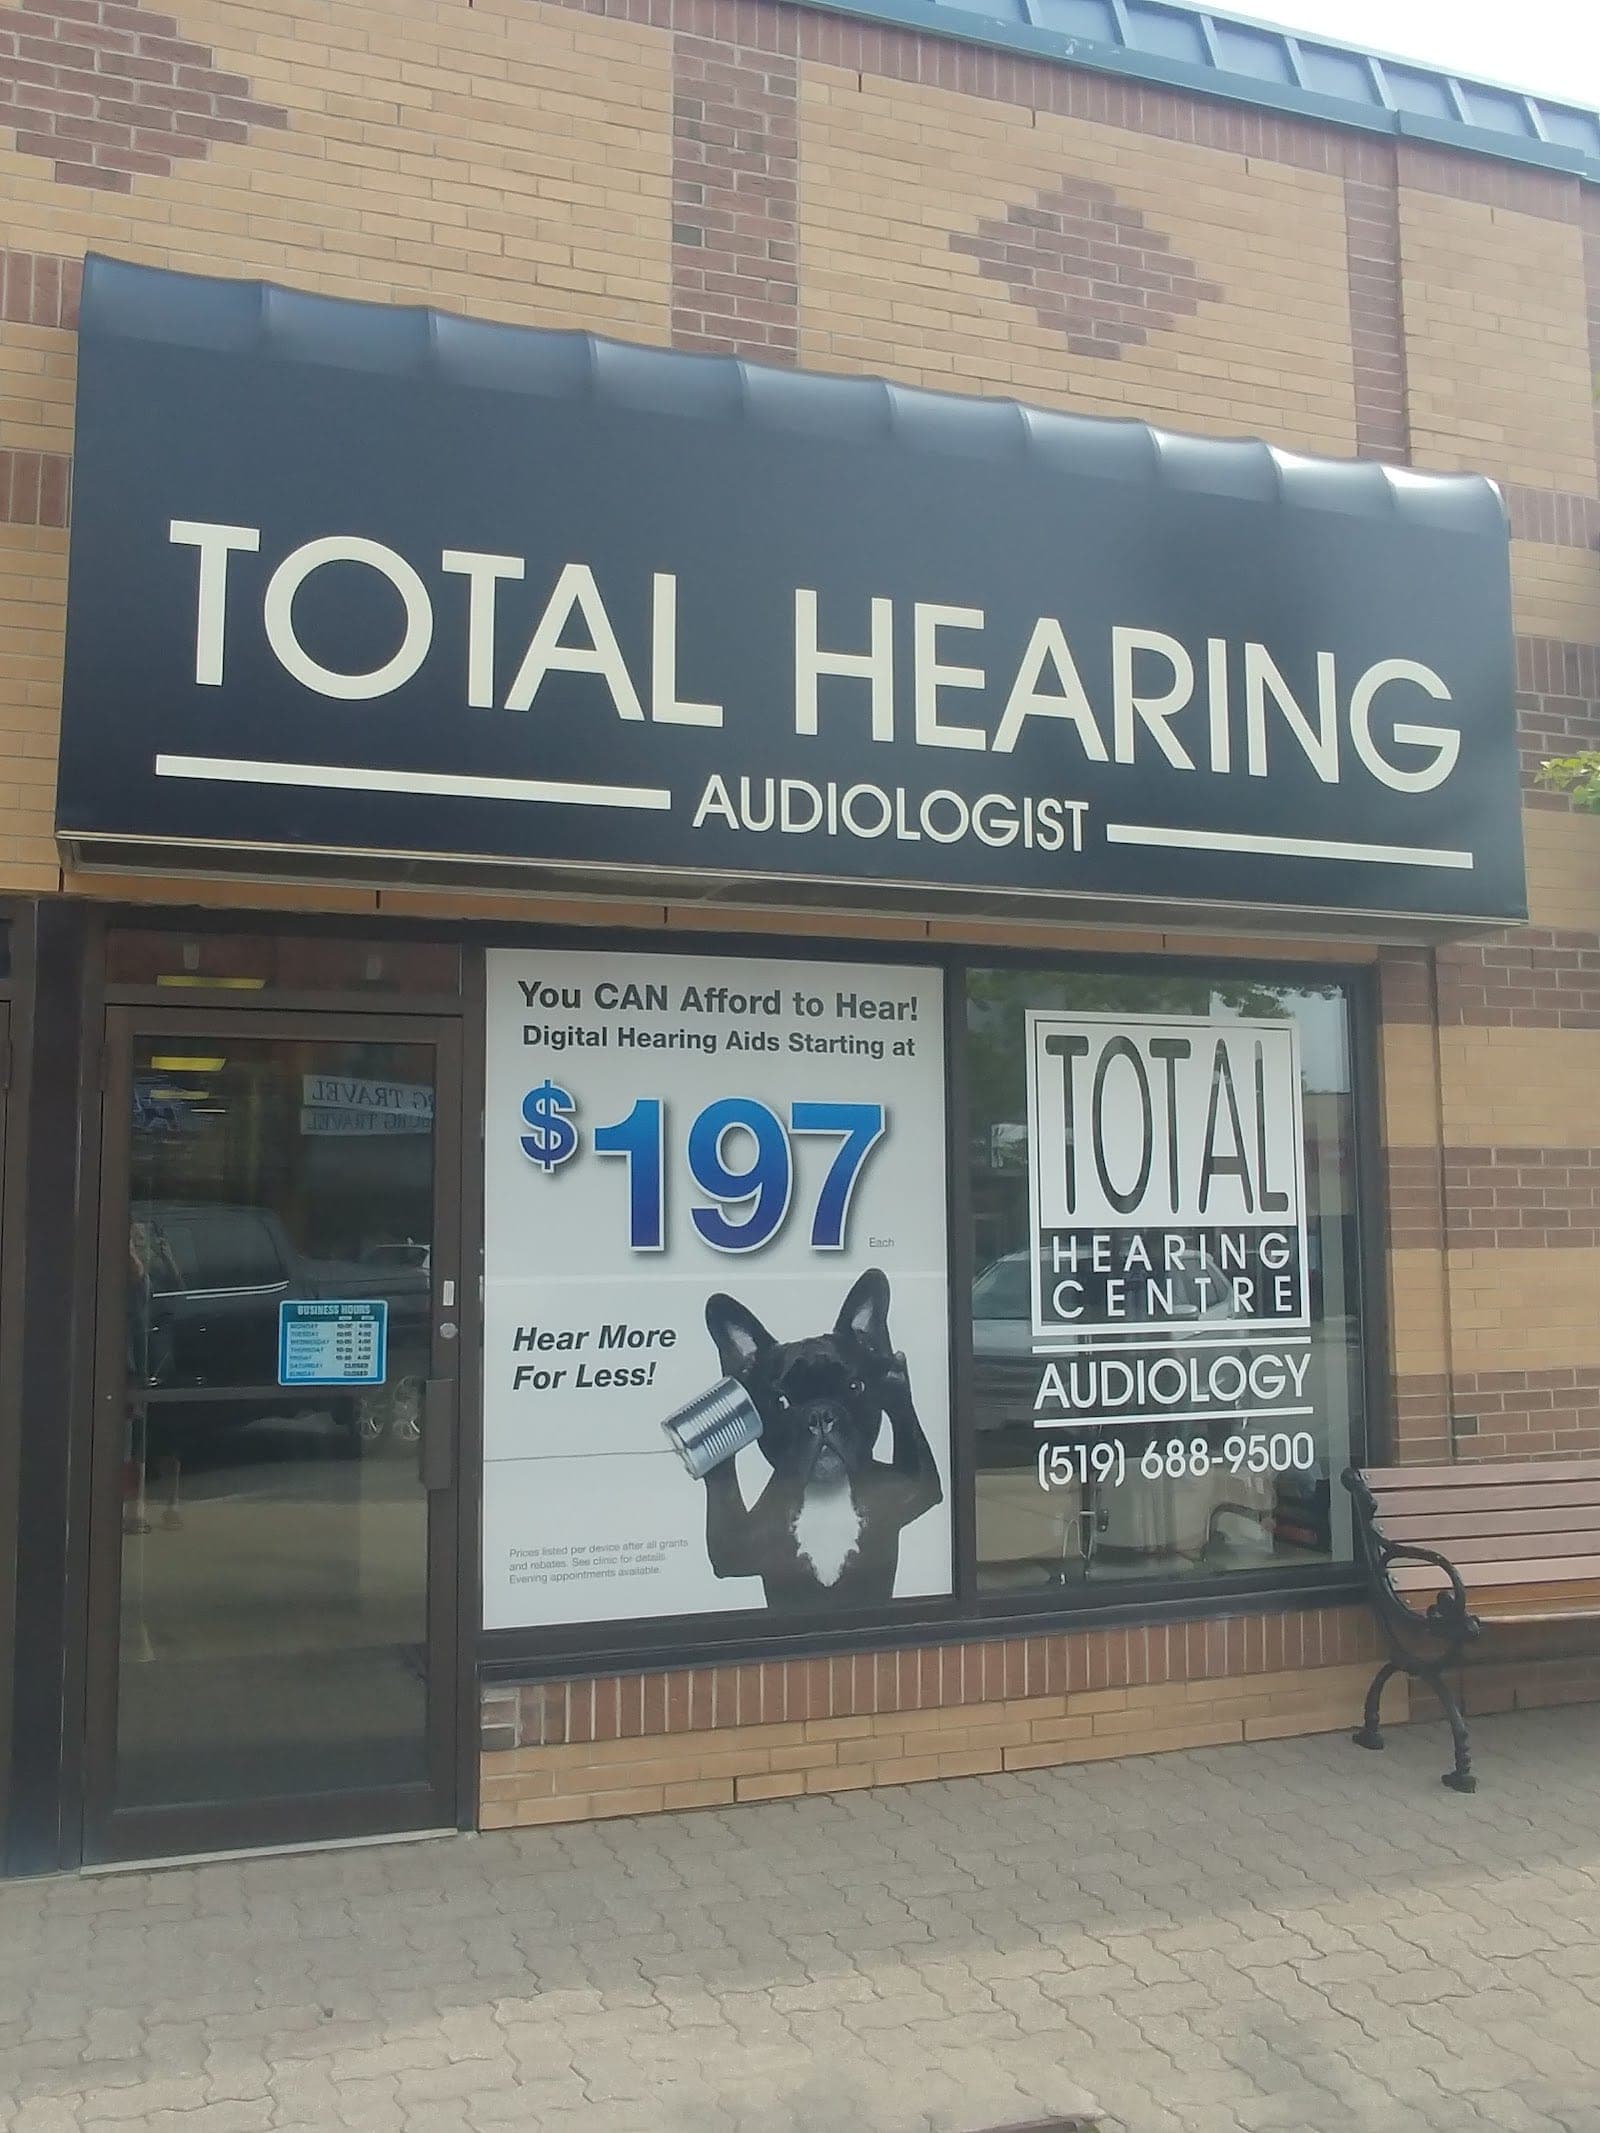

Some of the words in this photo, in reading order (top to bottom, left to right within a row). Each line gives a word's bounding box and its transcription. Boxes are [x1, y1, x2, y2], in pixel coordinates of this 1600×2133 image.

[169, 519, 723, 728] TOTAL
[795, 588, 1461, 793] HEARING
[692, 773, 1089, 853] AUDIOLOGIST
[519, 981, 580, 1009] You
[594, 983, 668, 1011] CAN
[680, 986, 781, 1015] Afford
[793, 990, 824, 1018] to
[836, 992, 919, 1021] Hear!
[522, 1025, 608, 1050] Digital
[618, 1027, 717, 1054] Hearing
[726, 1031, 780, 1052] Aids
[788, 1033, 884, 1060] Starting
[892, 1036, 916, 1057] at
[1045, 1034, 1289, 1215] TOTAL
[519, 1079, 886, 1254] $197
[869, 1236, 895, 1249] Each
[1053, 1233, 1290, 1273] HEARING
[297, 1305, 339, 1315] BUSINESS
[341, 1305, 370, 1314] HOURS
[1053, 1275, 1292, 1318] CENTRE
[512, 1327, 590, 1351] Hear
[599, 1325, 677, 1349] More
[512, 1364, 566, 1390] For
[575, 1362, 657, 1388] Less!
[1034, 1353, 1312, 1410] AUDIOLOGY
[1038, 1439, 1126, 1490] (519)
[1140, 1432, 1315, 1480] 688-9500
[509, 1549, 540, 1558] Prices
[542, 1546, 568, 1556] listed
[570, 1545, 585, 1556] per
[589, 1544, 620, 1553] device
[623, 1541, 643, 1551] after
[646, 1540, 657, 1549] all
[659, 1538, 688, 1550] grants
[509, 1562, 527, 1571] and
[572, 1557, 591, 1567] See
[593, 1556, 617, 1566] clinic
[620, 1554, 633, 1563] for
[509, 1573, 547, 1584] Evening
[550, 1569, 616, 1583] appointments
